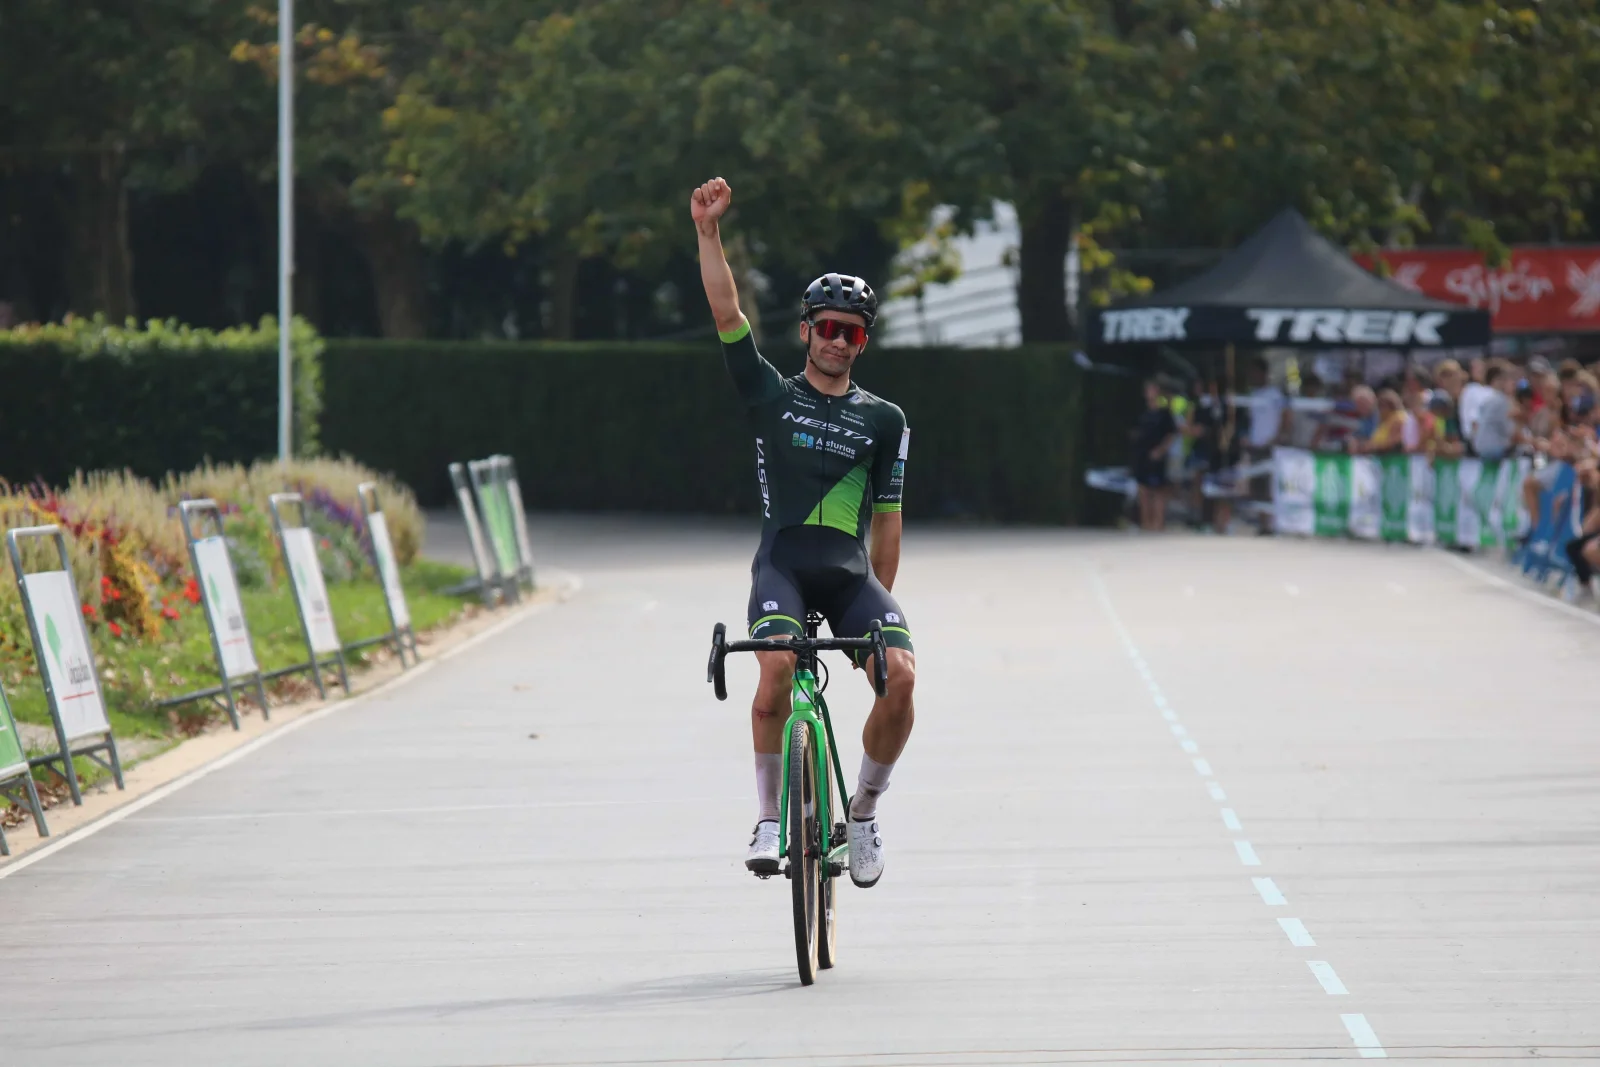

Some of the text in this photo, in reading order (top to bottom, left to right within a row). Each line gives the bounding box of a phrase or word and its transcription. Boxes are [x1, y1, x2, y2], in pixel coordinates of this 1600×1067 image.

[1101, 307, 1191, 343] TREK
[1246, 308, 1450, 346] TREK
[782, 411, 873, 446] NESTA
[816, 437, 856, 455] Asturias
[756, 437, 771, 519] NESTA
